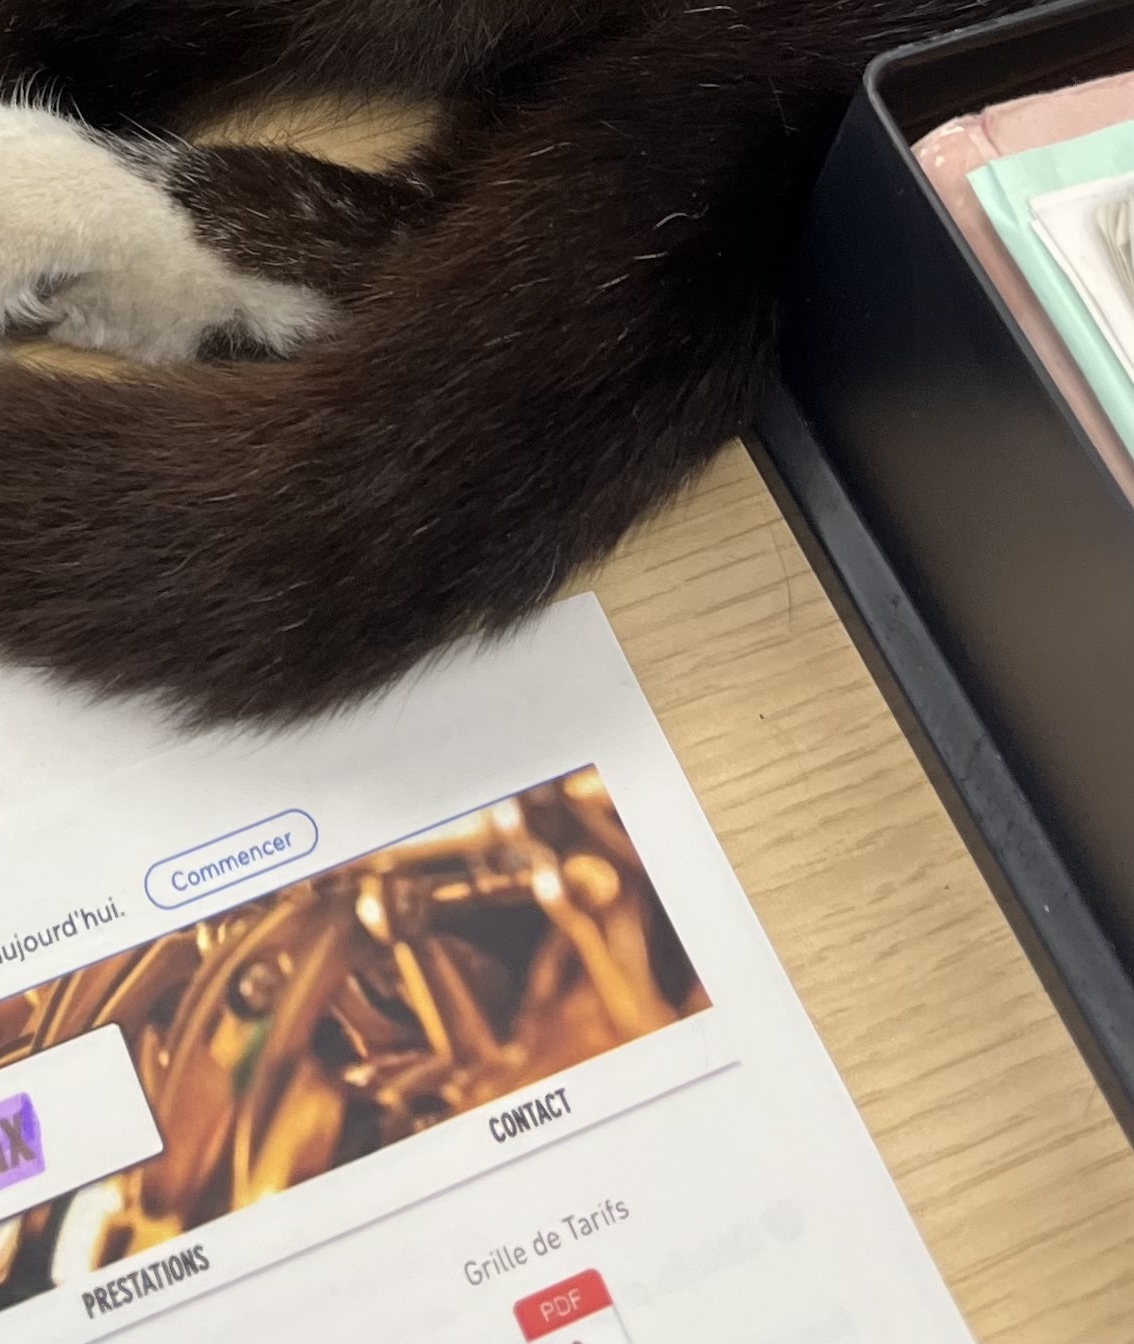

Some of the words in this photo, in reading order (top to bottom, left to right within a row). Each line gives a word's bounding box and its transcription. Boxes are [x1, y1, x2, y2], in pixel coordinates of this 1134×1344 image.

[171, 832, 291, 891] Commencer
[489, 1087, 572, 1143] CONTACT
[464, 1246, 528, 1286] Grille
[532, 1230, 561, 1256] de
[561, 1198, 630, 1241] Tarifs
[81, 1244, 210, 1320] PRESTATIONS
[540, 1288, 583, 1323] PDF
